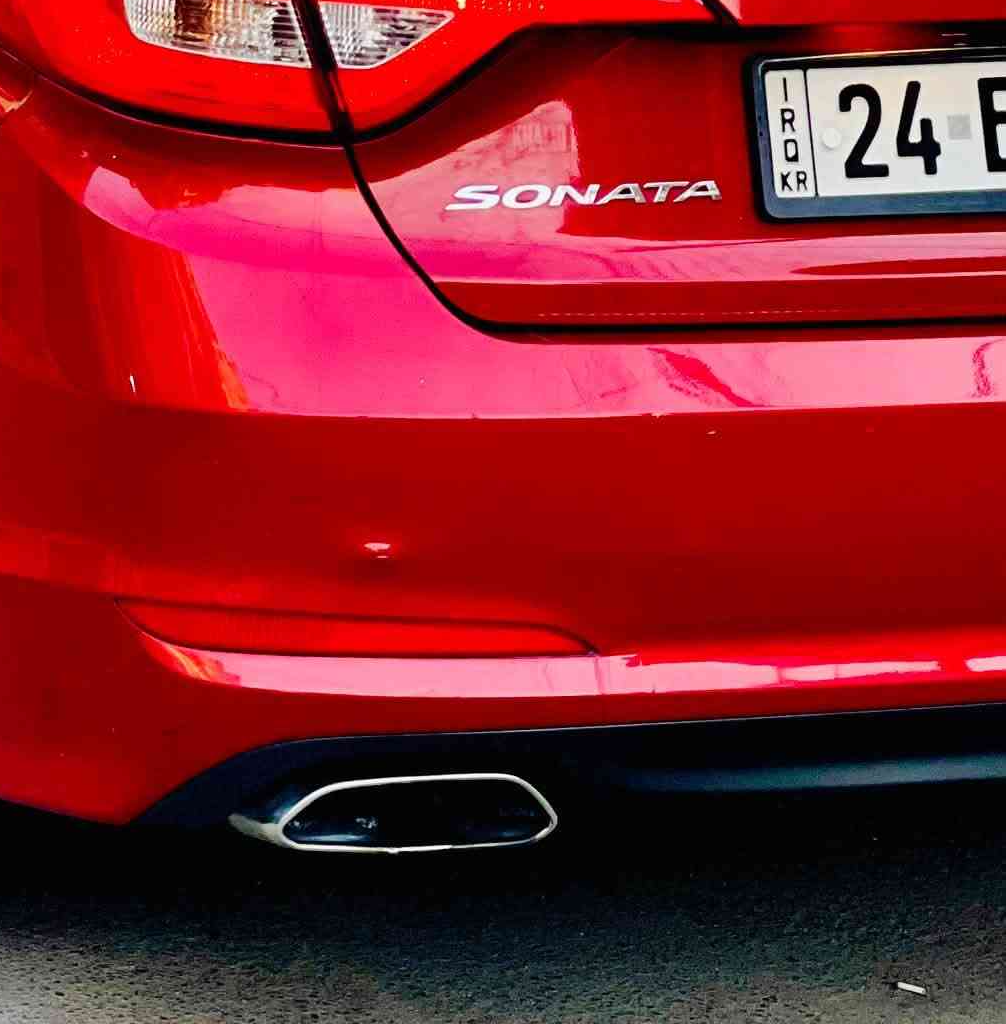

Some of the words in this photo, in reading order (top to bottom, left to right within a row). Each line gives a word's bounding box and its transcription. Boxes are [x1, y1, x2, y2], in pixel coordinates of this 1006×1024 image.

[838, 80, 942, 179] 24
[445, 180, 723, 211] SONATA
[780, 170, 808, 193] KR
